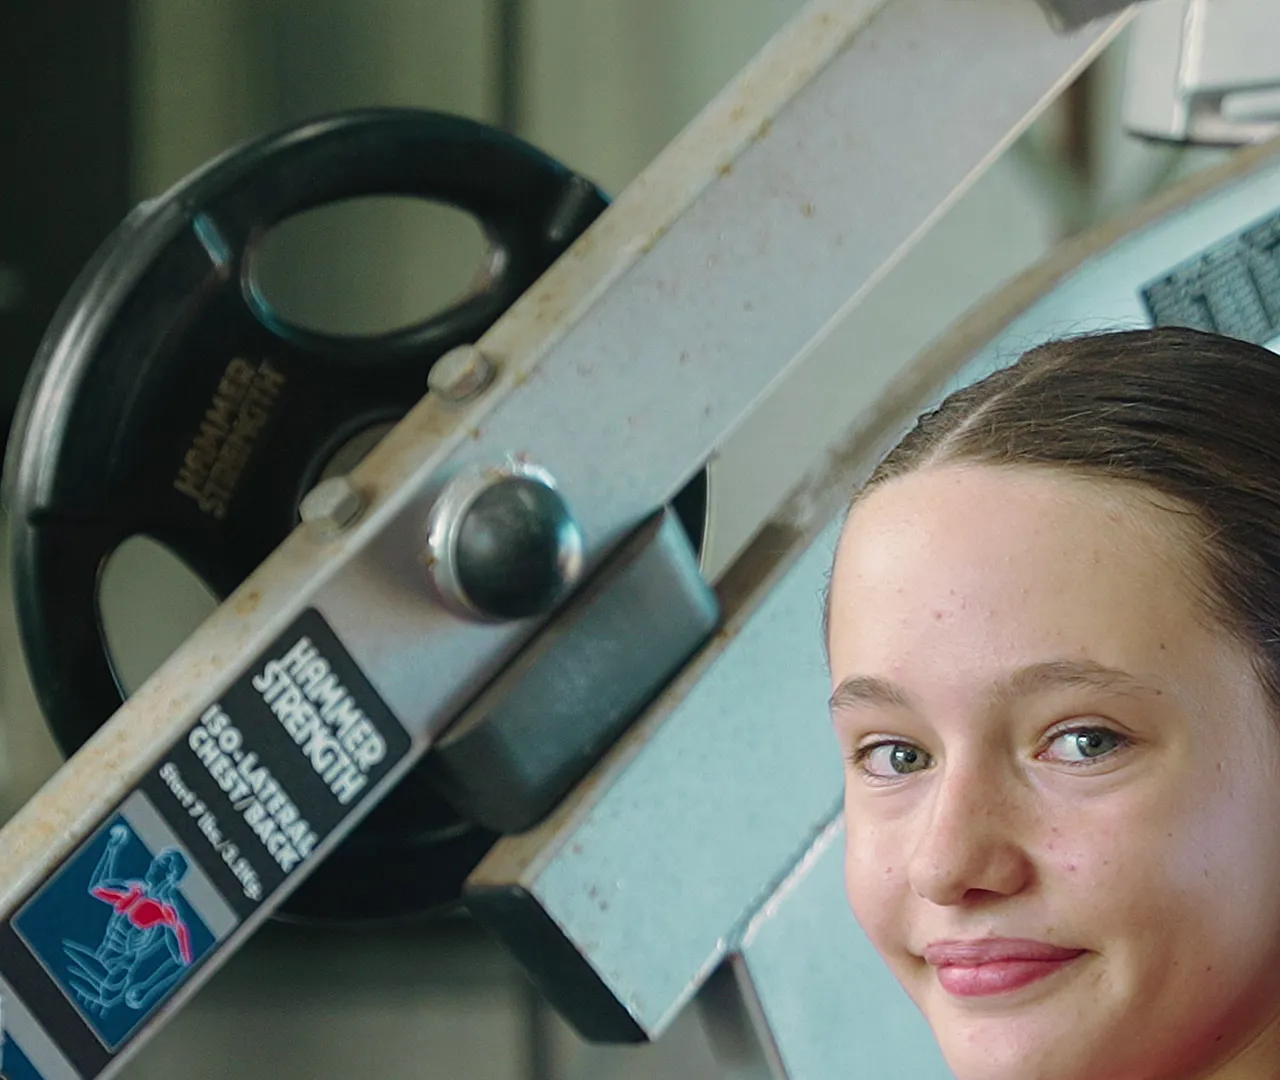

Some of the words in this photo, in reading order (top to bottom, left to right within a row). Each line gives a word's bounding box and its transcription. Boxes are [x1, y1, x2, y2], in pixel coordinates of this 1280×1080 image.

[173, 357, 256, 501] HAMMER
[198, 358, 286, 519] STRENGTH
[252, 660, 369, 805] STRENGTH
[278, 636, 387, 774] HAMMER
[159, 762, 196, 808] Start
[188, 726, 301, 873] CHEST/BACK
[200, 701, 319, 859] ISO-LATERAL
